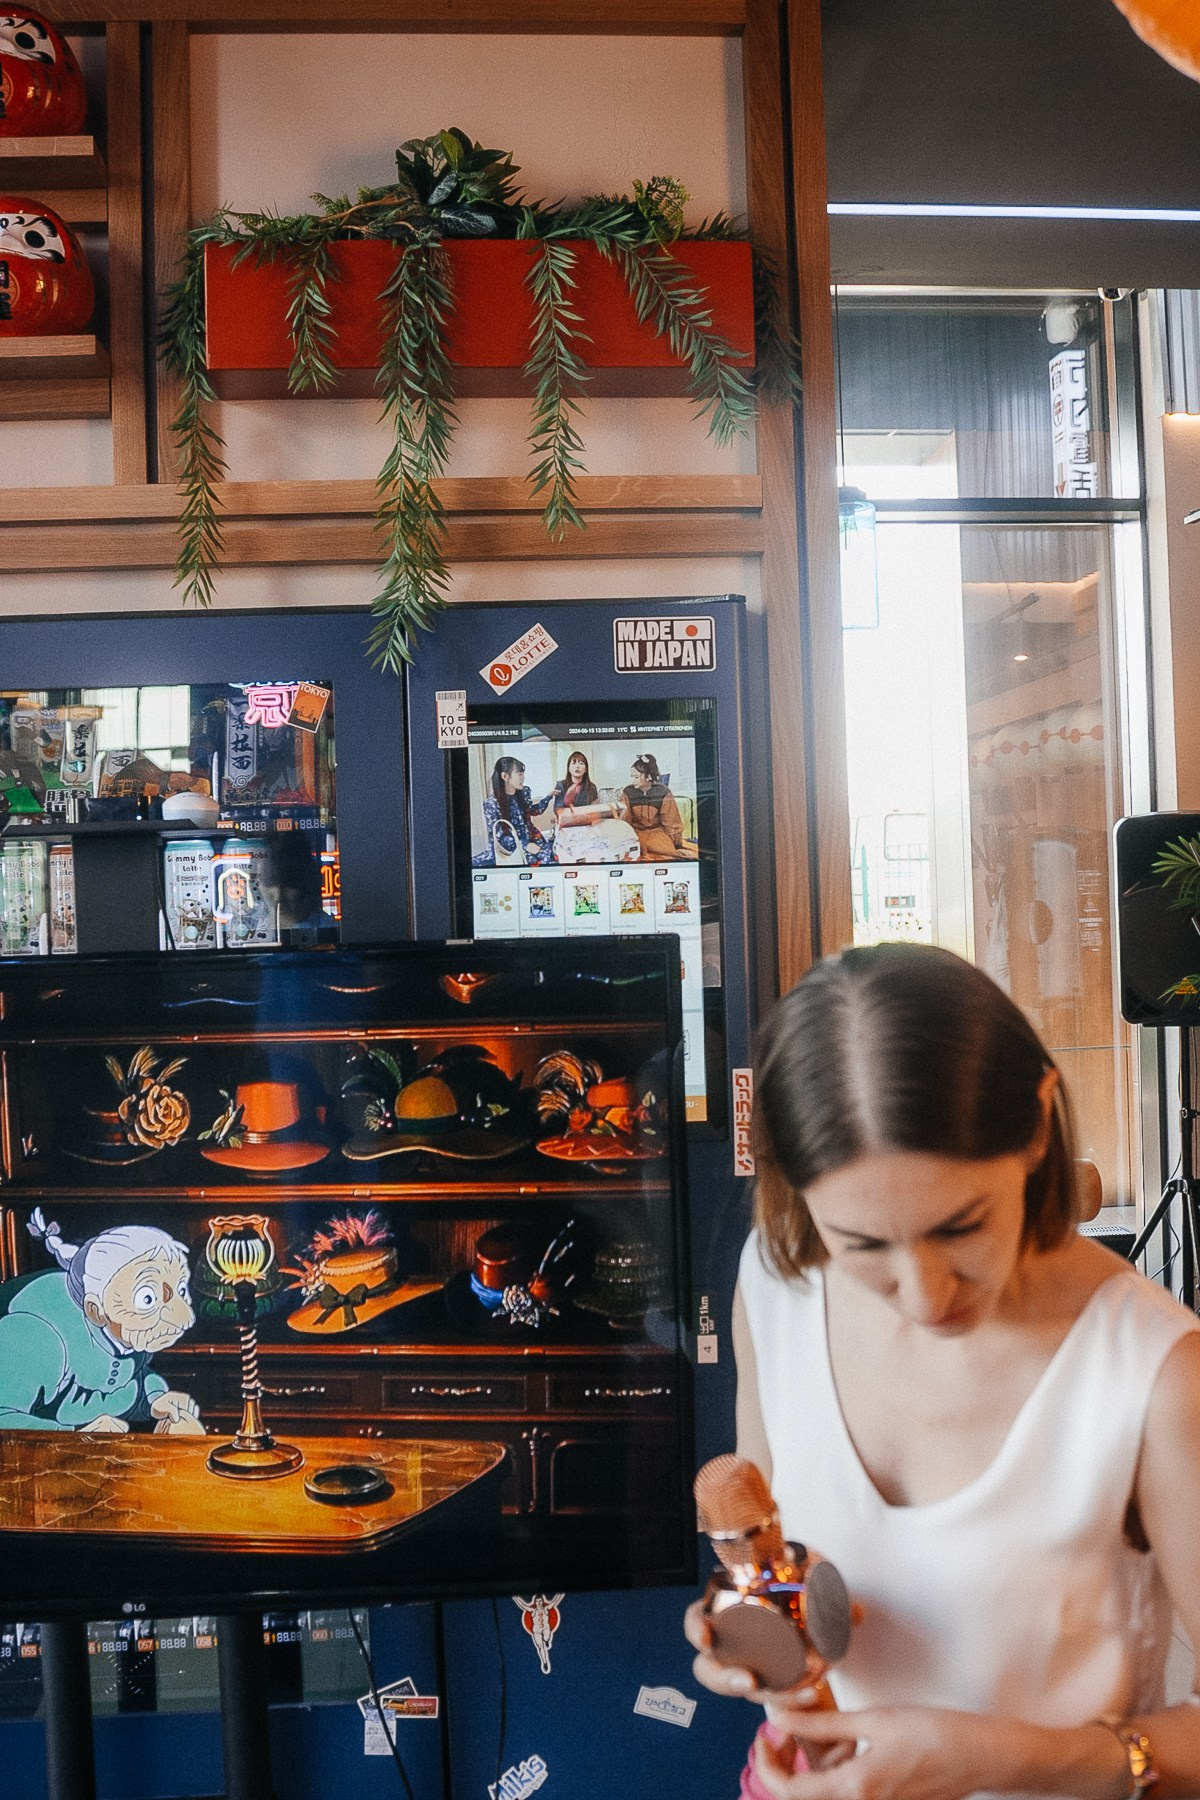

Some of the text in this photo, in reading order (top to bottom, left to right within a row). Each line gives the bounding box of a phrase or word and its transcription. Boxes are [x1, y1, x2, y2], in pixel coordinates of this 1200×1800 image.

[617, 620, 672, 641] MADE
[512, 638, 551, 672] LOTTE
[617, 640, 711, 668] IN JAPAN
[299, 683, 328, 699] TOKYO
[439, 715, 455, 725] TO
[440, 726, 464, 737] KYO
[276, 820, 293, 830] 010
[167, 853, 213, 864] Gmmy Bob
[134, 1603, 146, 1612] LG
[335, 1628, 355, 1639] 88.8
